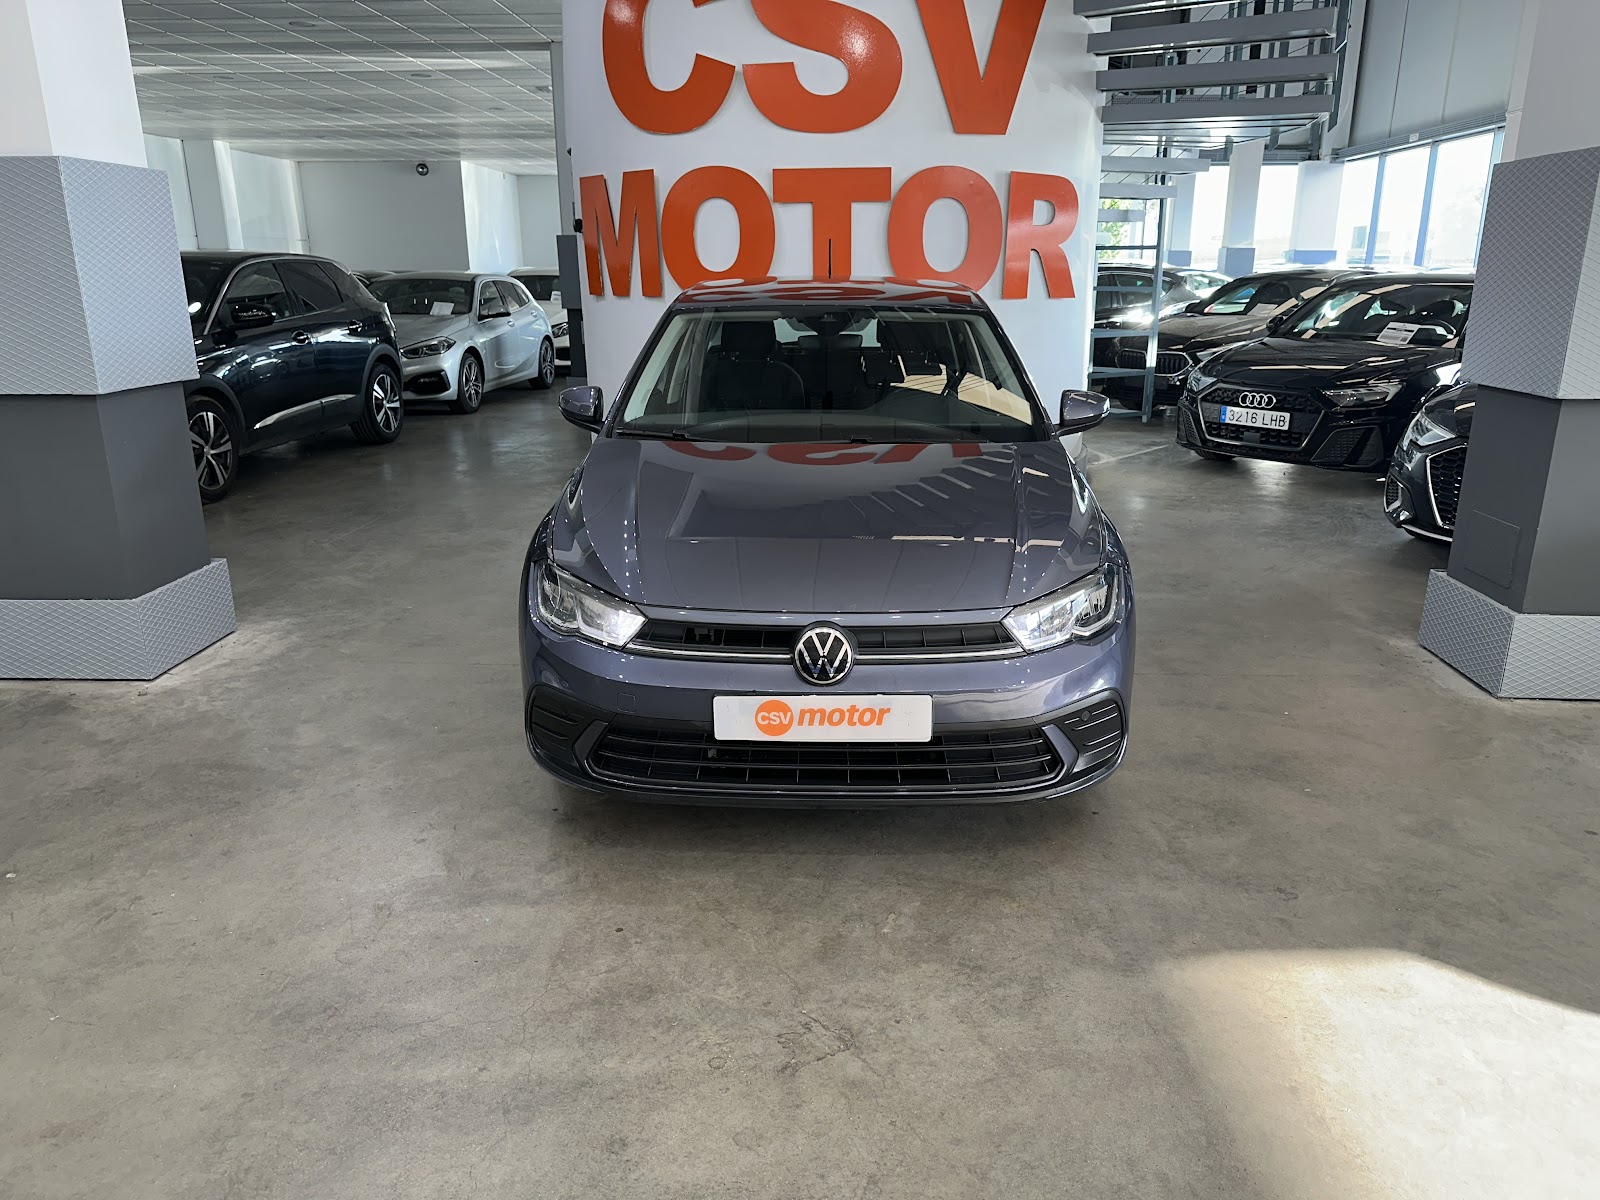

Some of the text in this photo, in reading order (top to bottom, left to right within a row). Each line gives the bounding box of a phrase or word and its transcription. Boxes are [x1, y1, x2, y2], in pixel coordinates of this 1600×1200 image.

[602, 0, 1046, 135] CSV
[579, 165, 1079, 299] MOTOR
[1228, 409, 1287, 428] 3216 LHB
[757, 704, 891, 727] CSV motor
